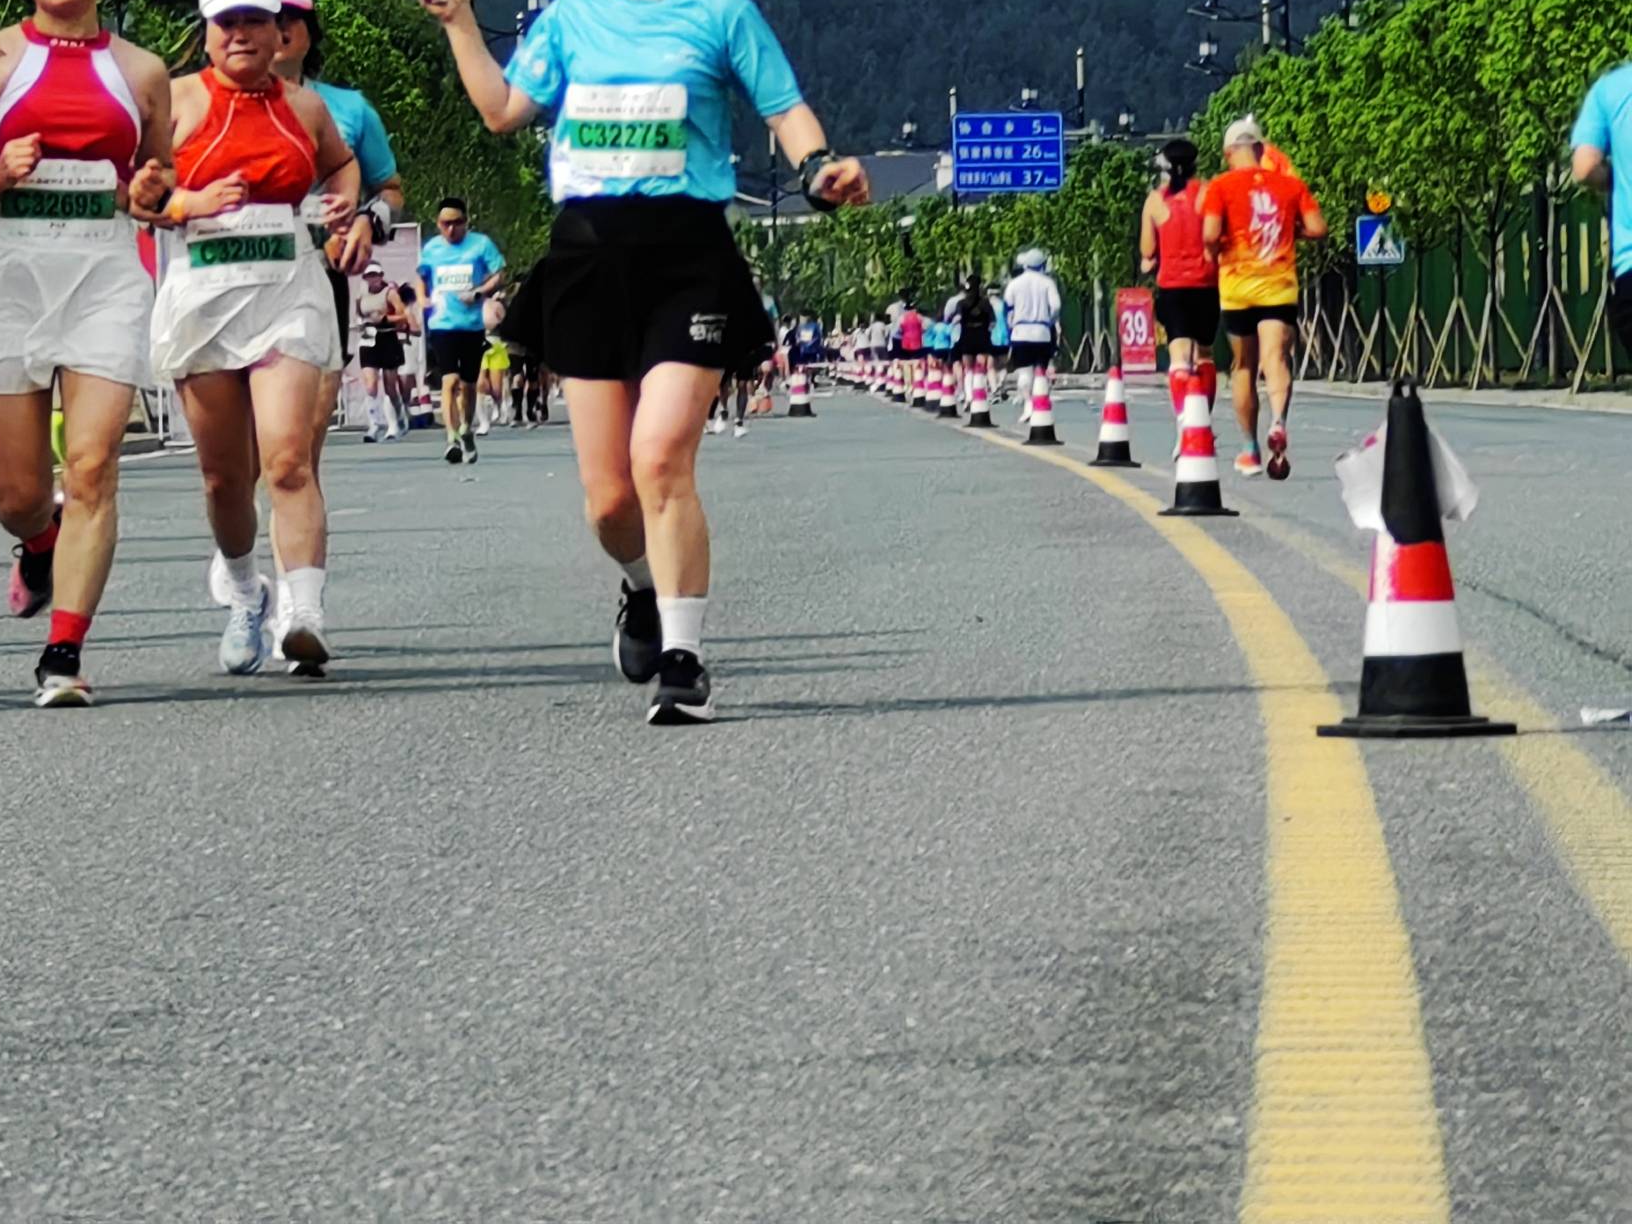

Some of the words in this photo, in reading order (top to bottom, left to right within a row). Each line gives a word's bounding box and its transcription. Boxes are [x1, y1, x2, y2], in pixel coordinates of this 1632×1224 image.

[578, 122, 669, 148] C32275
[1032, 119, 1041, 135] 5
[1022, 144, 1042, 159] 26
[1023, 170, 1043, 185] 37
[1120, 310, 1148, 345] 39
